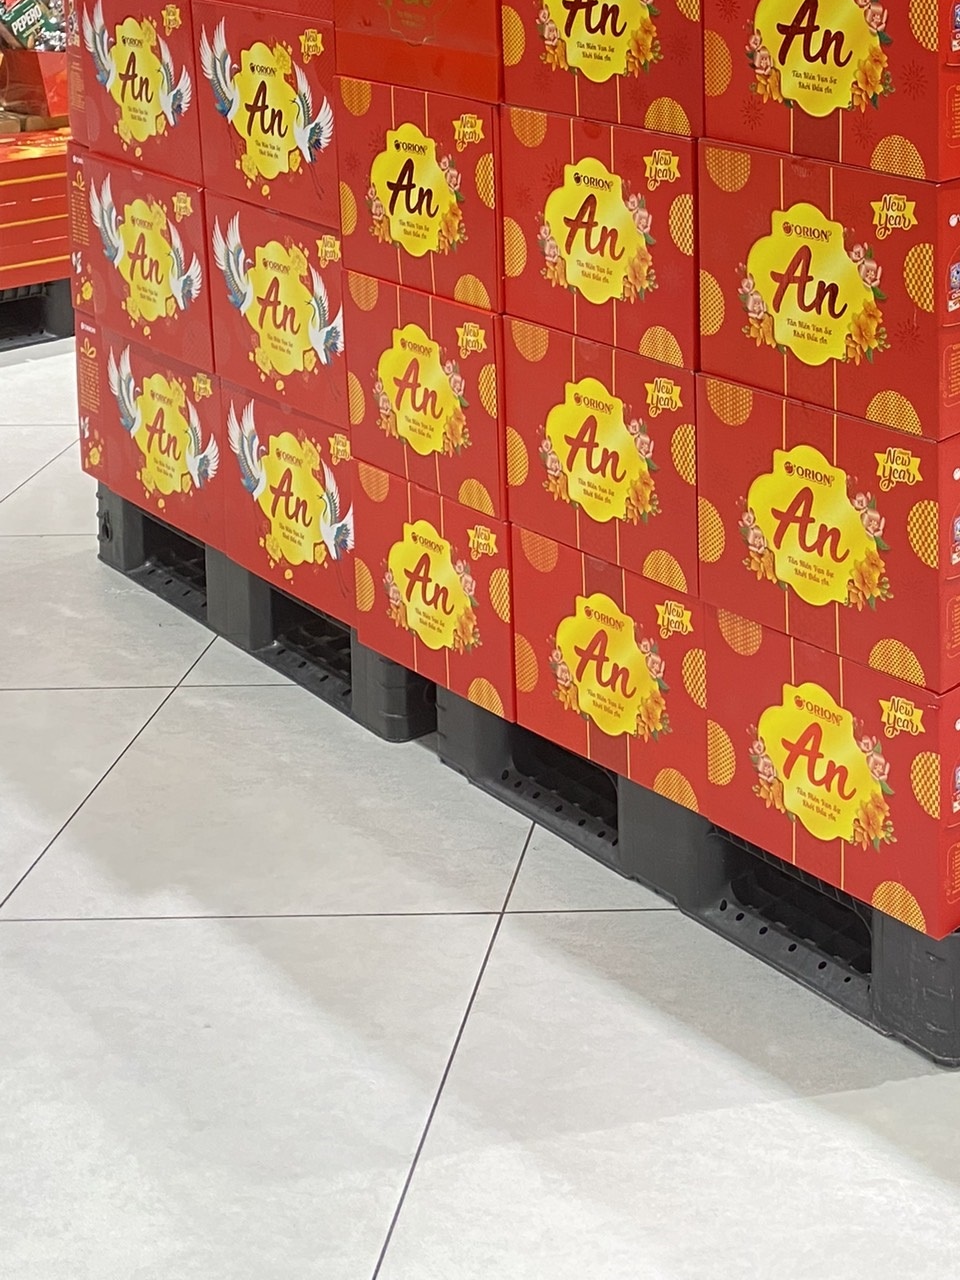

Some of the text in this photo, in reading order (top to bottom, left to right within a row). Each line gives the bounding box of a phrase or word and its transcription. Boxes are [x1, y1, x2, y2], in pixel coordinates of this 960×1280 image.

[11, 4, 42, 35] PEPERO
[119, 52, 154, 104] An
[245, 80, 288, 138] An
[461, 117, 477, 129] New
[402, 143, 425, 154] ORION
[457, 129, 481, 151] Year
[652, 152, 672, 166] New
[387, 158, 439, 218] An
[583, 176, 611, 189] ORION
[649, 166, 676, 190] Year
[880, 196, 906, 213] New
[564, 194, 625, 261] An
[792, 224, 828, 241] ORION
[878, 212, 911, 239] Year
[128, 232, 163, 285] An
[770, 245, 848, 319] An
[256, 276, 300, 335] An
[463, 324, 479, 337] New
[408, 341, 431, 356] ORION
[393, 358, 443, 419] An
[653, 380, 674, 394] New
[583, 396, 611, 413] ORION
[650, 393, 678, 416] Year
[146, 408, 181, 461] An
[564, 415, 626, 482] An
[884, 449, 911, 467] New
[797, 466, 831, 486] ORION
[880, 465, 916, 490] Year
[270, 468, 312, 527] An
[771, 487, 850, 563] An
[404, 553, 454, 615] An
[664, 602, 685, 617] New
[594, 613, 623, 631] ORION
[660, 615, 688, 638] Year
[574, 629, 637, 699] An
[806, 701, 840, 725] ORION
[890, 697, 914, 716] New
[886, 713, 919, 737] Year
[781, 722, 856, 801] An
